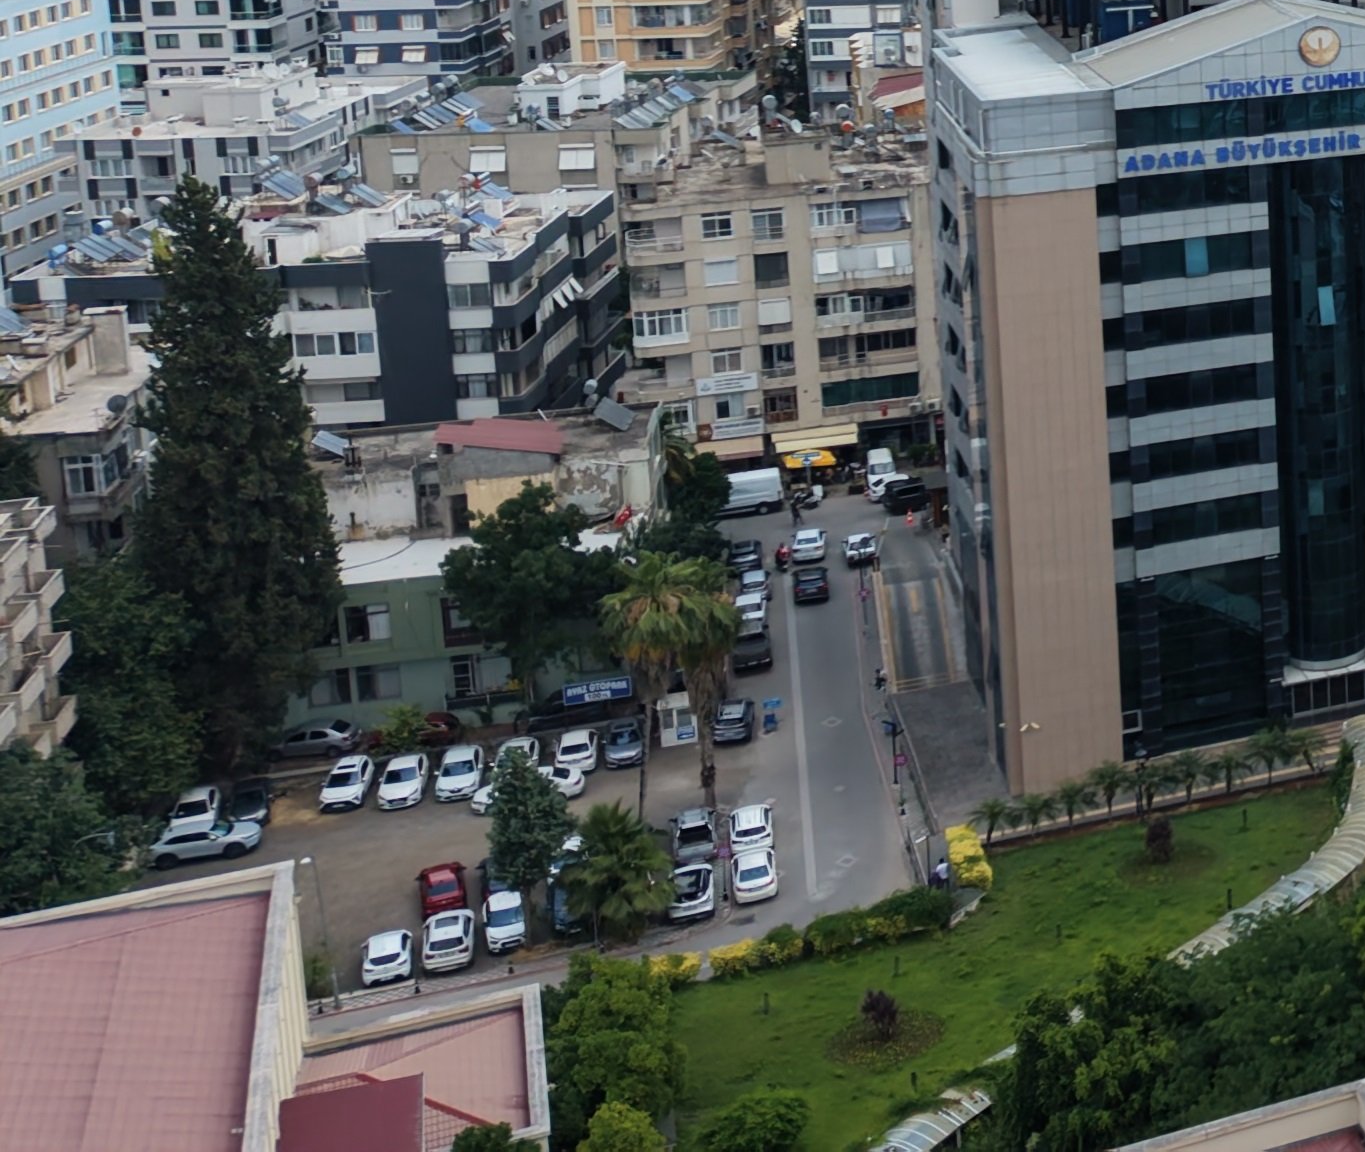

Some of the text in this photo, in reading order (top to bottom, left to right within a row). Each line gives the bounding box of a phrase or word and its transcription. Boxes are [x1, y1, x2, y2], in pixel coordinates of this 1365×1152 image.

[1205, 76, 1293, 100] TÜRKİYE
[1124, 149, 1206, 173] ADANA
[1216, 130, 1361, 164] BÜYÜKŞEHİR
